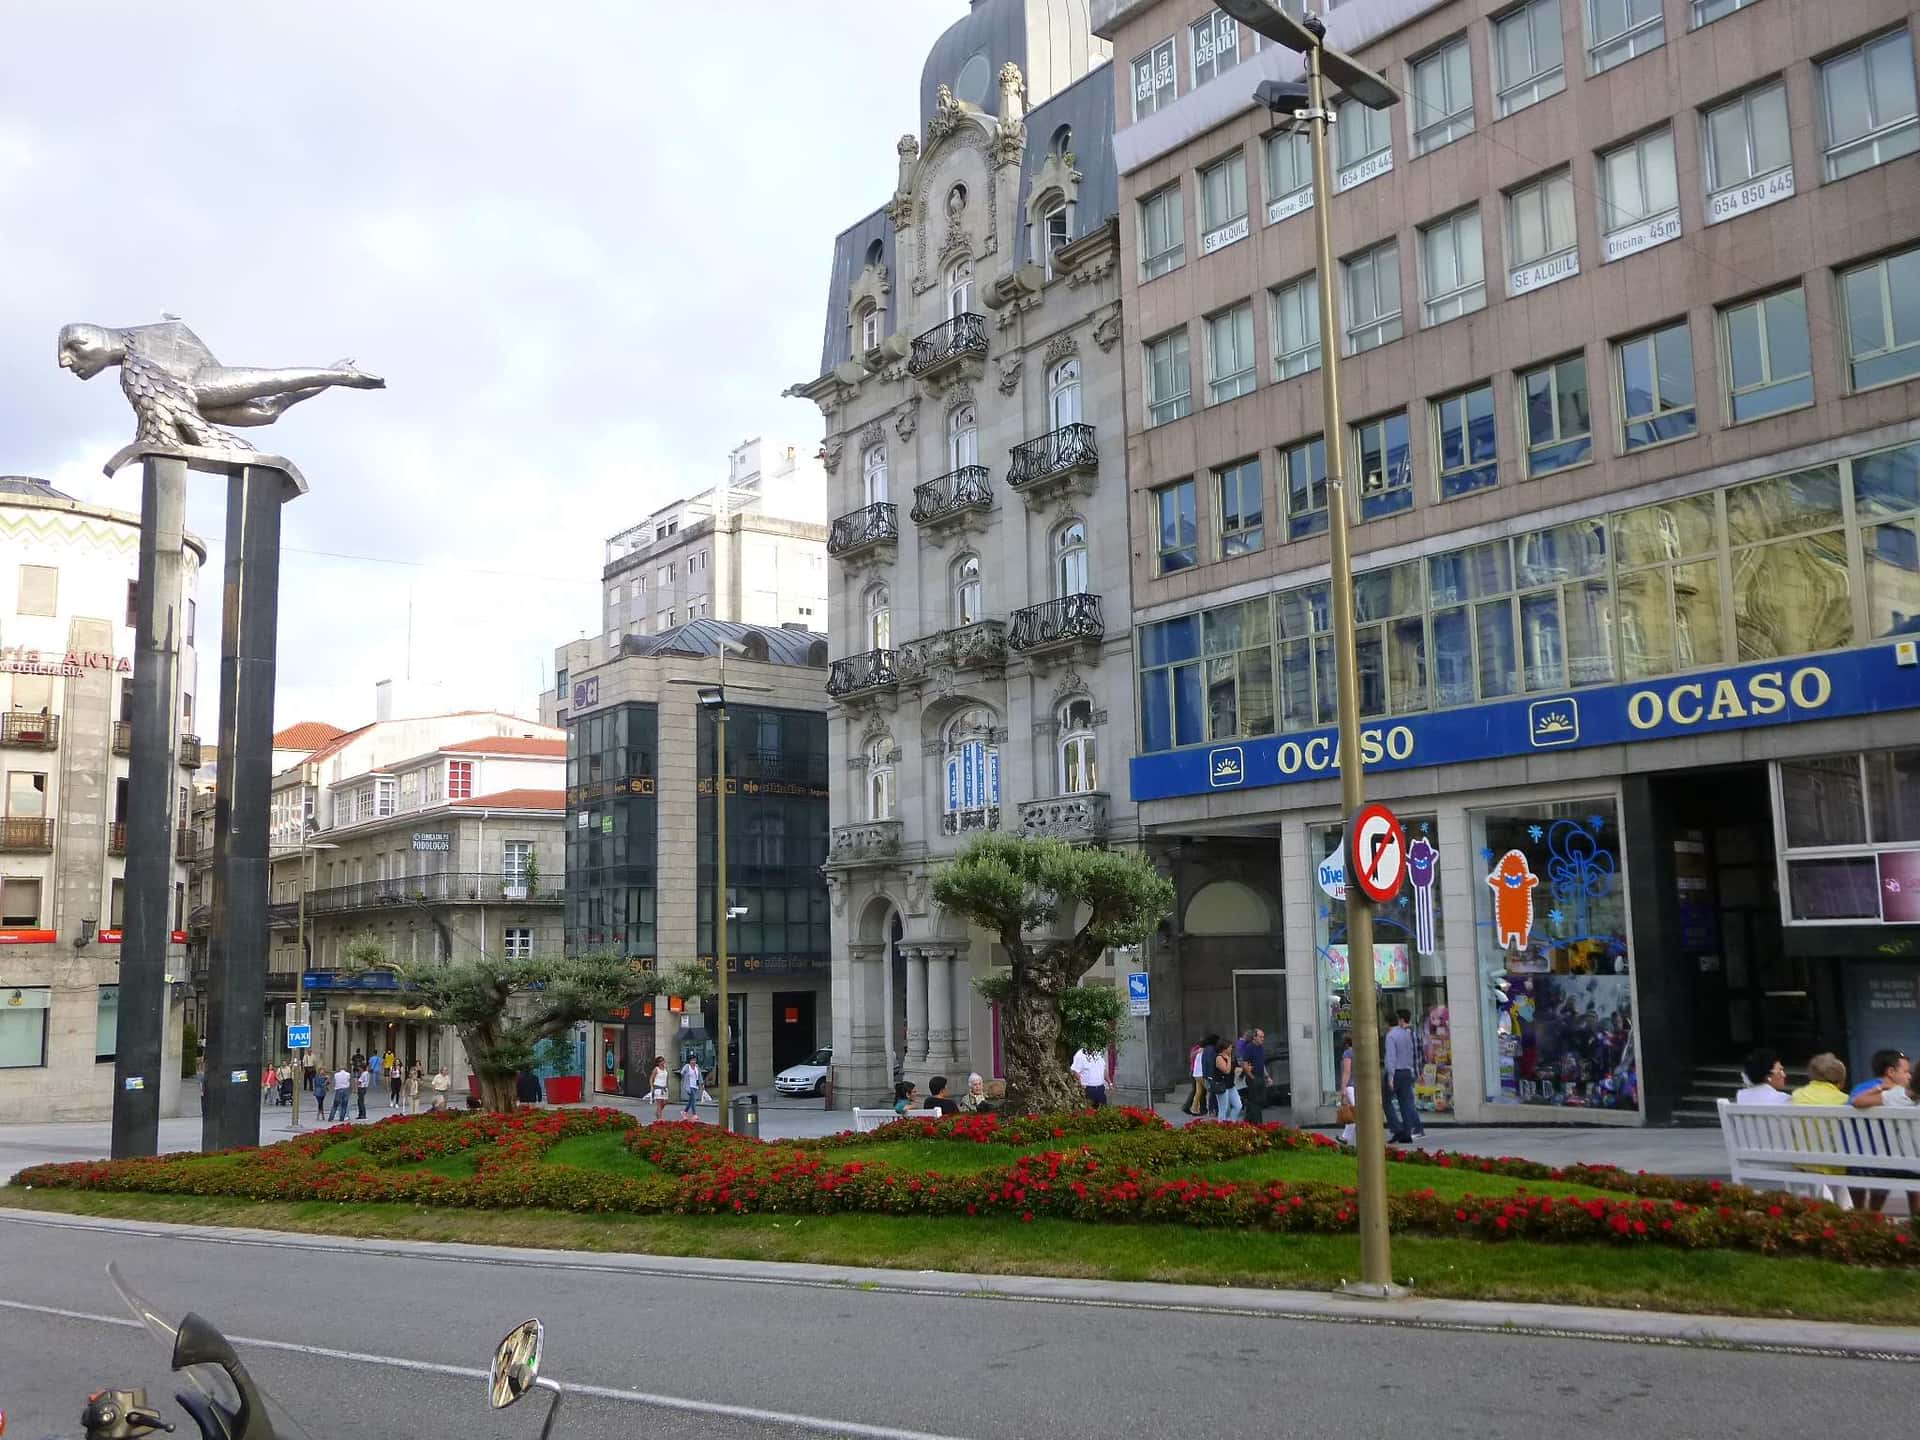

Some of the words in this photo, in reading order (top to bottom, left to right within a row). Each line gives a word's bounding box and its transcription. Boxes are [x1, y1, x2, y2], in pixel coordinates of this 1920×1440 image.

[1342, 169, 1358, 186] 654
[1361, 160, 1376, 178] 850
[1714, 197, 1738, 215] 654
[1742, 183, 1765, 206] 850
[1769, 172, 1793, 195] 445
[1206, 234, 1217, 250] SE
[1608, 235, 1646, 255] Oficina:
[1515, 271, 1529, 288] SE
[64, 648, 131, 672] ANTA
[1627, 665, 1832, 730] OCASO
[1320, 865, 1345, 885] Dive
[1335, 884, 1345, 896] ju
